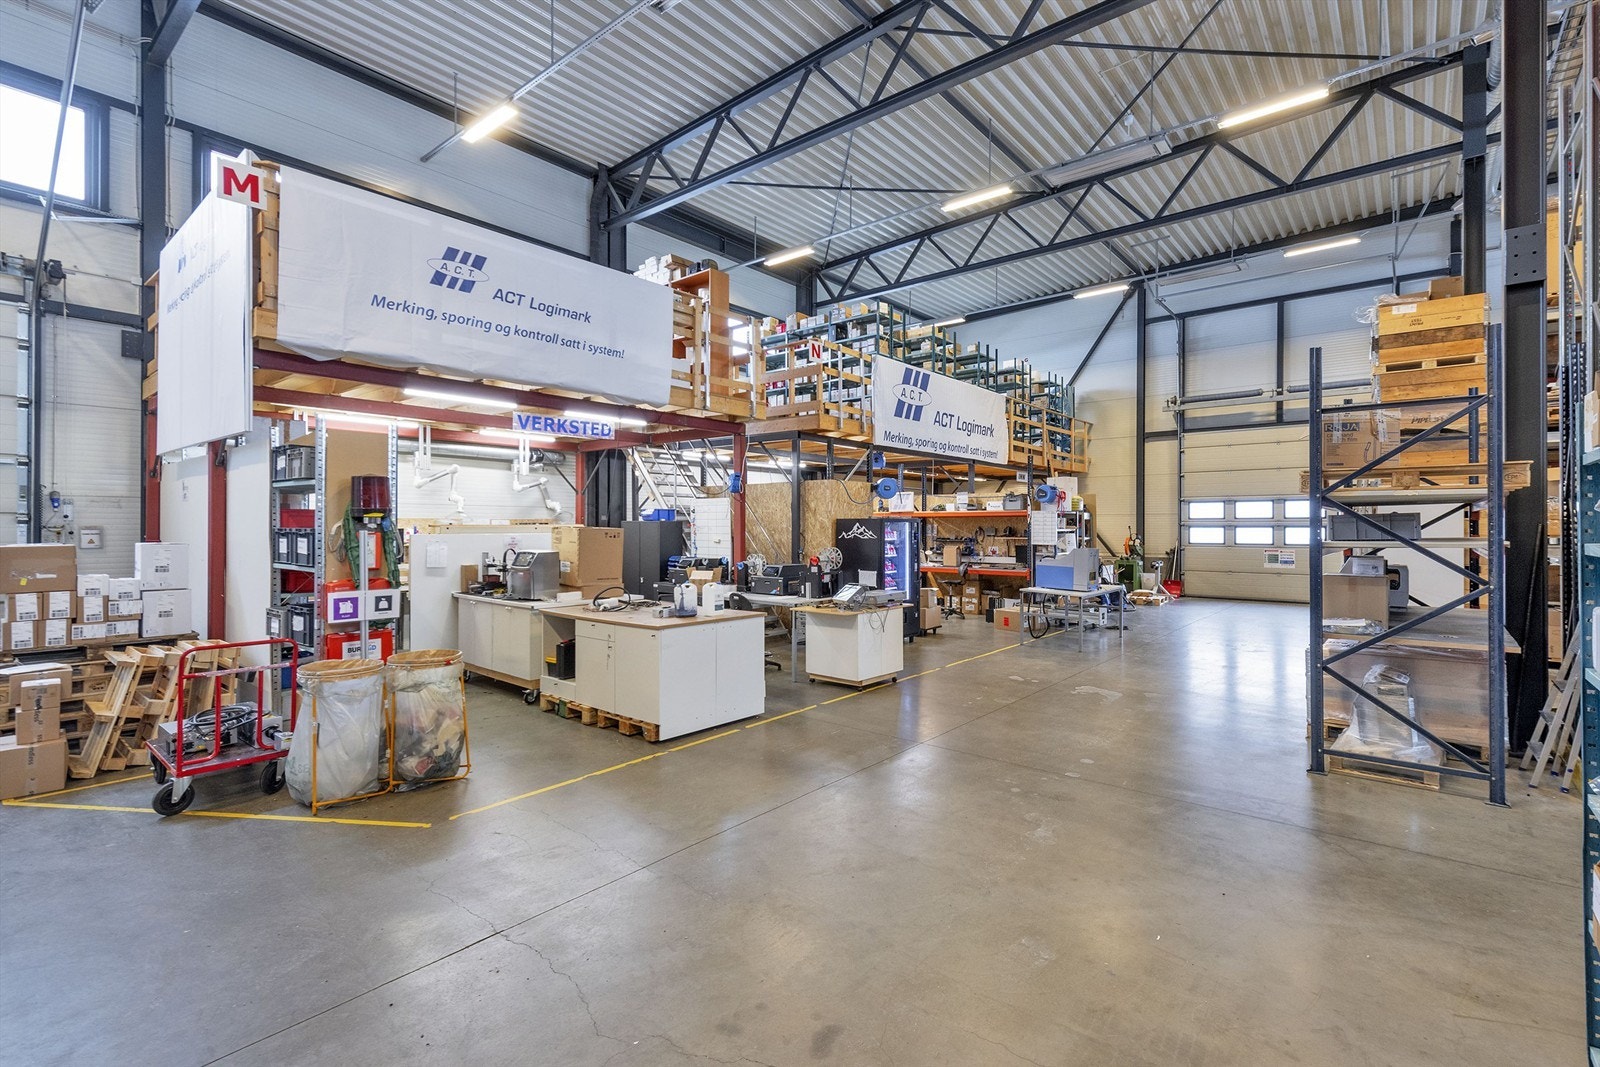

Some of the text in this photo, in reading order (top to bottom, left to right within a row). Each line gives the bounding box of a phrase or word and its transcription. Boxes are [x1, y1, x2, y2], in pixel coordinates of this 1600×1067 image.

[223, 166, 260, 204] M
[492, 288, 592, 324] ACT Logimark
[370, 294, 625, 359] Merking, sporing og kontroll satt i system!
[812, 343, 820, 358] N
[517, 414, 612, 436] VERKSTED
[933, 410, 994, 438] ACT Logimark
[883, 430, 914, 448] Merking,
[915, 437, 938, 452] sporing
[939, 442, 946, 452] og
[948, 441, 969, 454] kontroll
[970, 448, 979, 456] satt
[982, 449, 998, 459] system!
